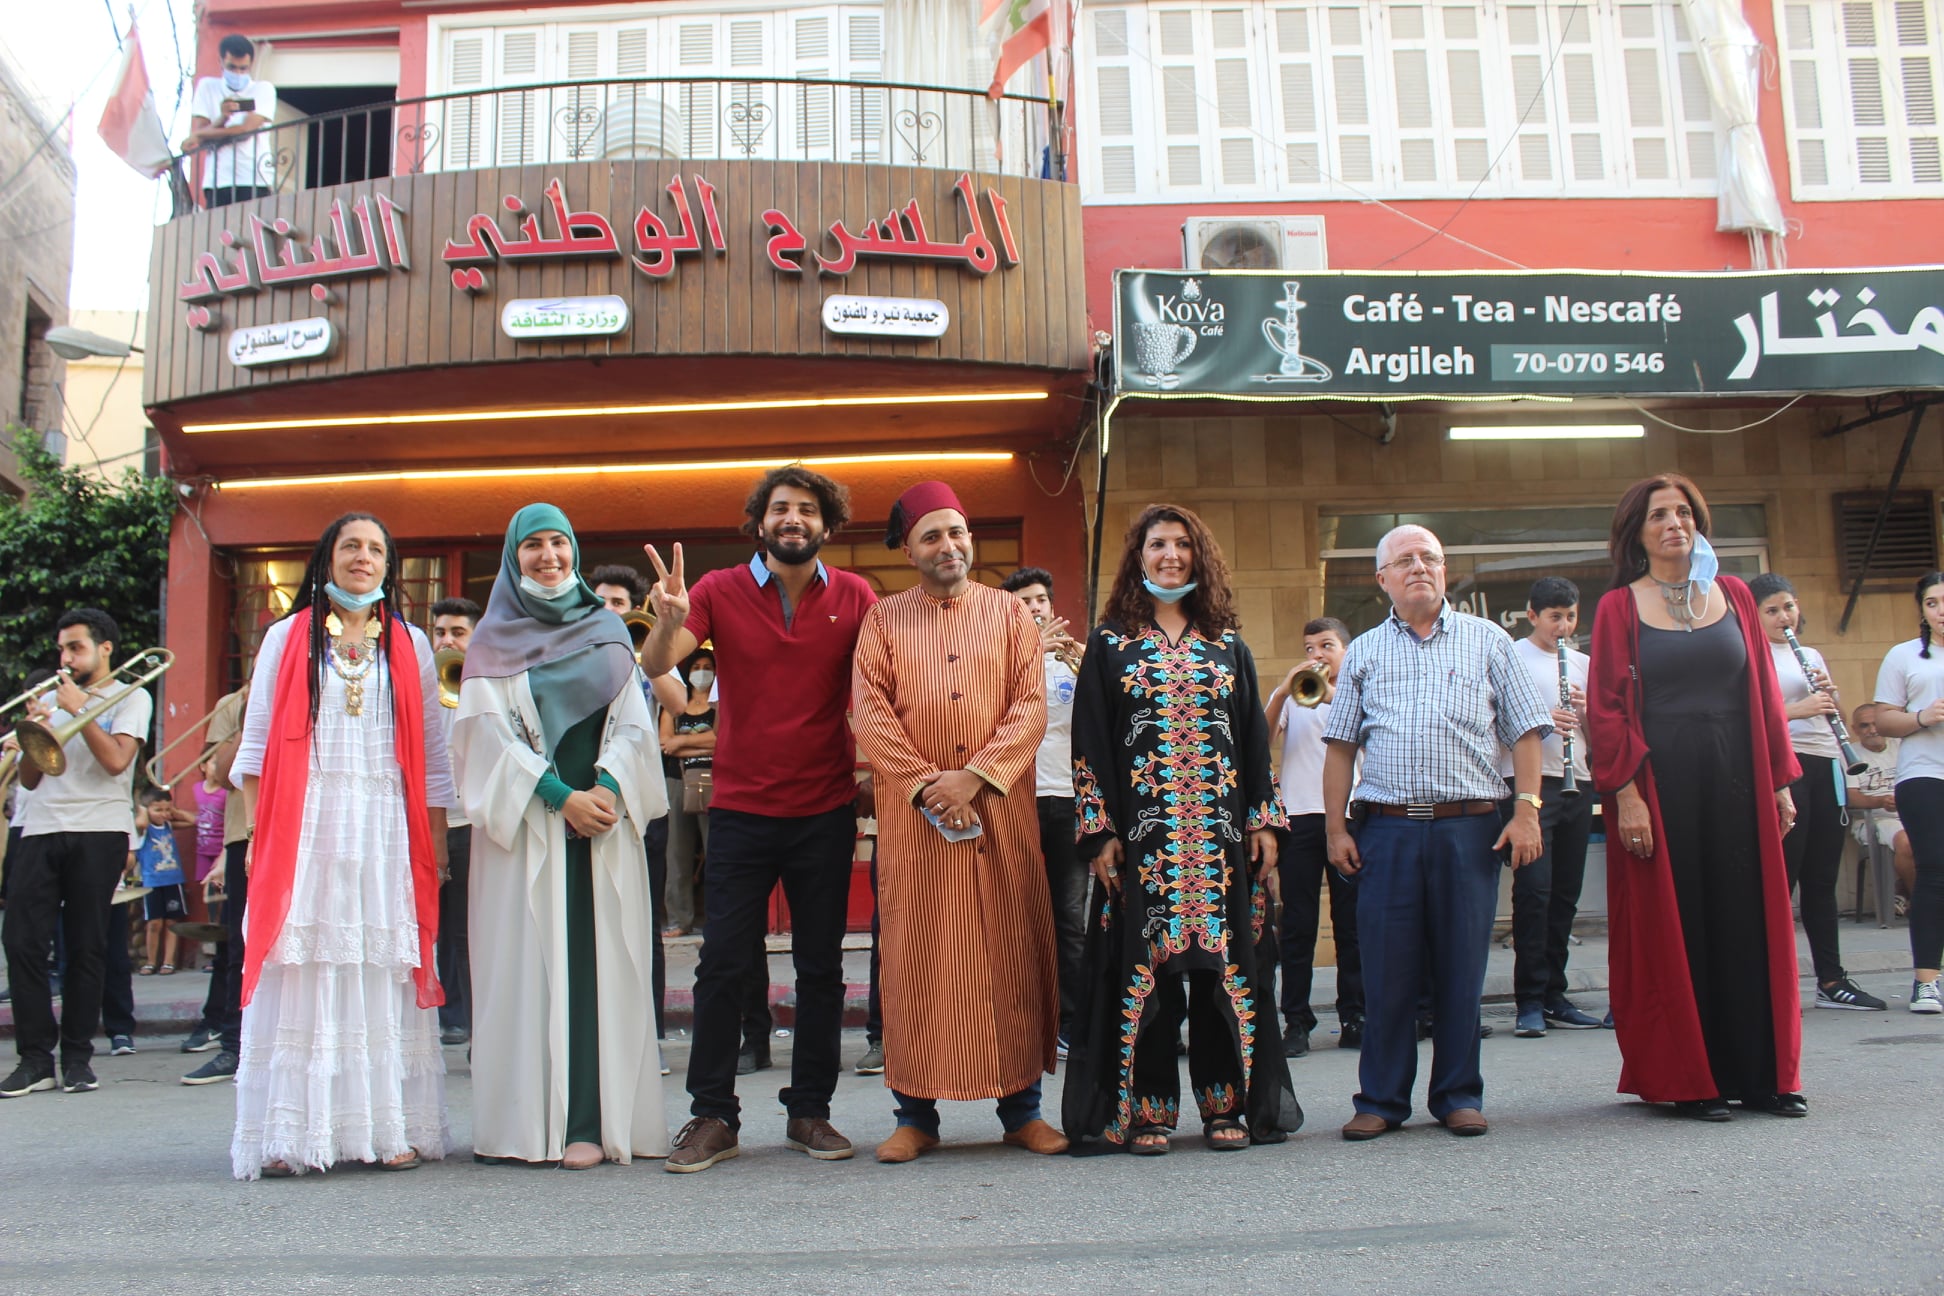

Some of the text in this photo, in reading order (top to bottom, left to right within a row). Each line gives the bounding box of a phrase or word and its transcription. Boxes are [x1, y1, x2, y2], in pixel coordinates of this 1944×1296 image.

[180, 172, 1020, 329] المسرح الوطني اللبناني
[511, 310, 618, 328] وزارة الثقافة
[832, 301, 868, 324] للفنون
[903, 307, 939, 327] جمعية
[1343, 293, 1423, 323] Café
[1452, 295, 1515, 323] Tea
[1545, 293, 1682, 323] Nescafé
[291, 327, 323, 350] مسرح
[1200, 325, 1224, 337] Café
[1344, 346, 1475, 383] Argileh
[1513, 352, 1665, 373] 70-070 546
